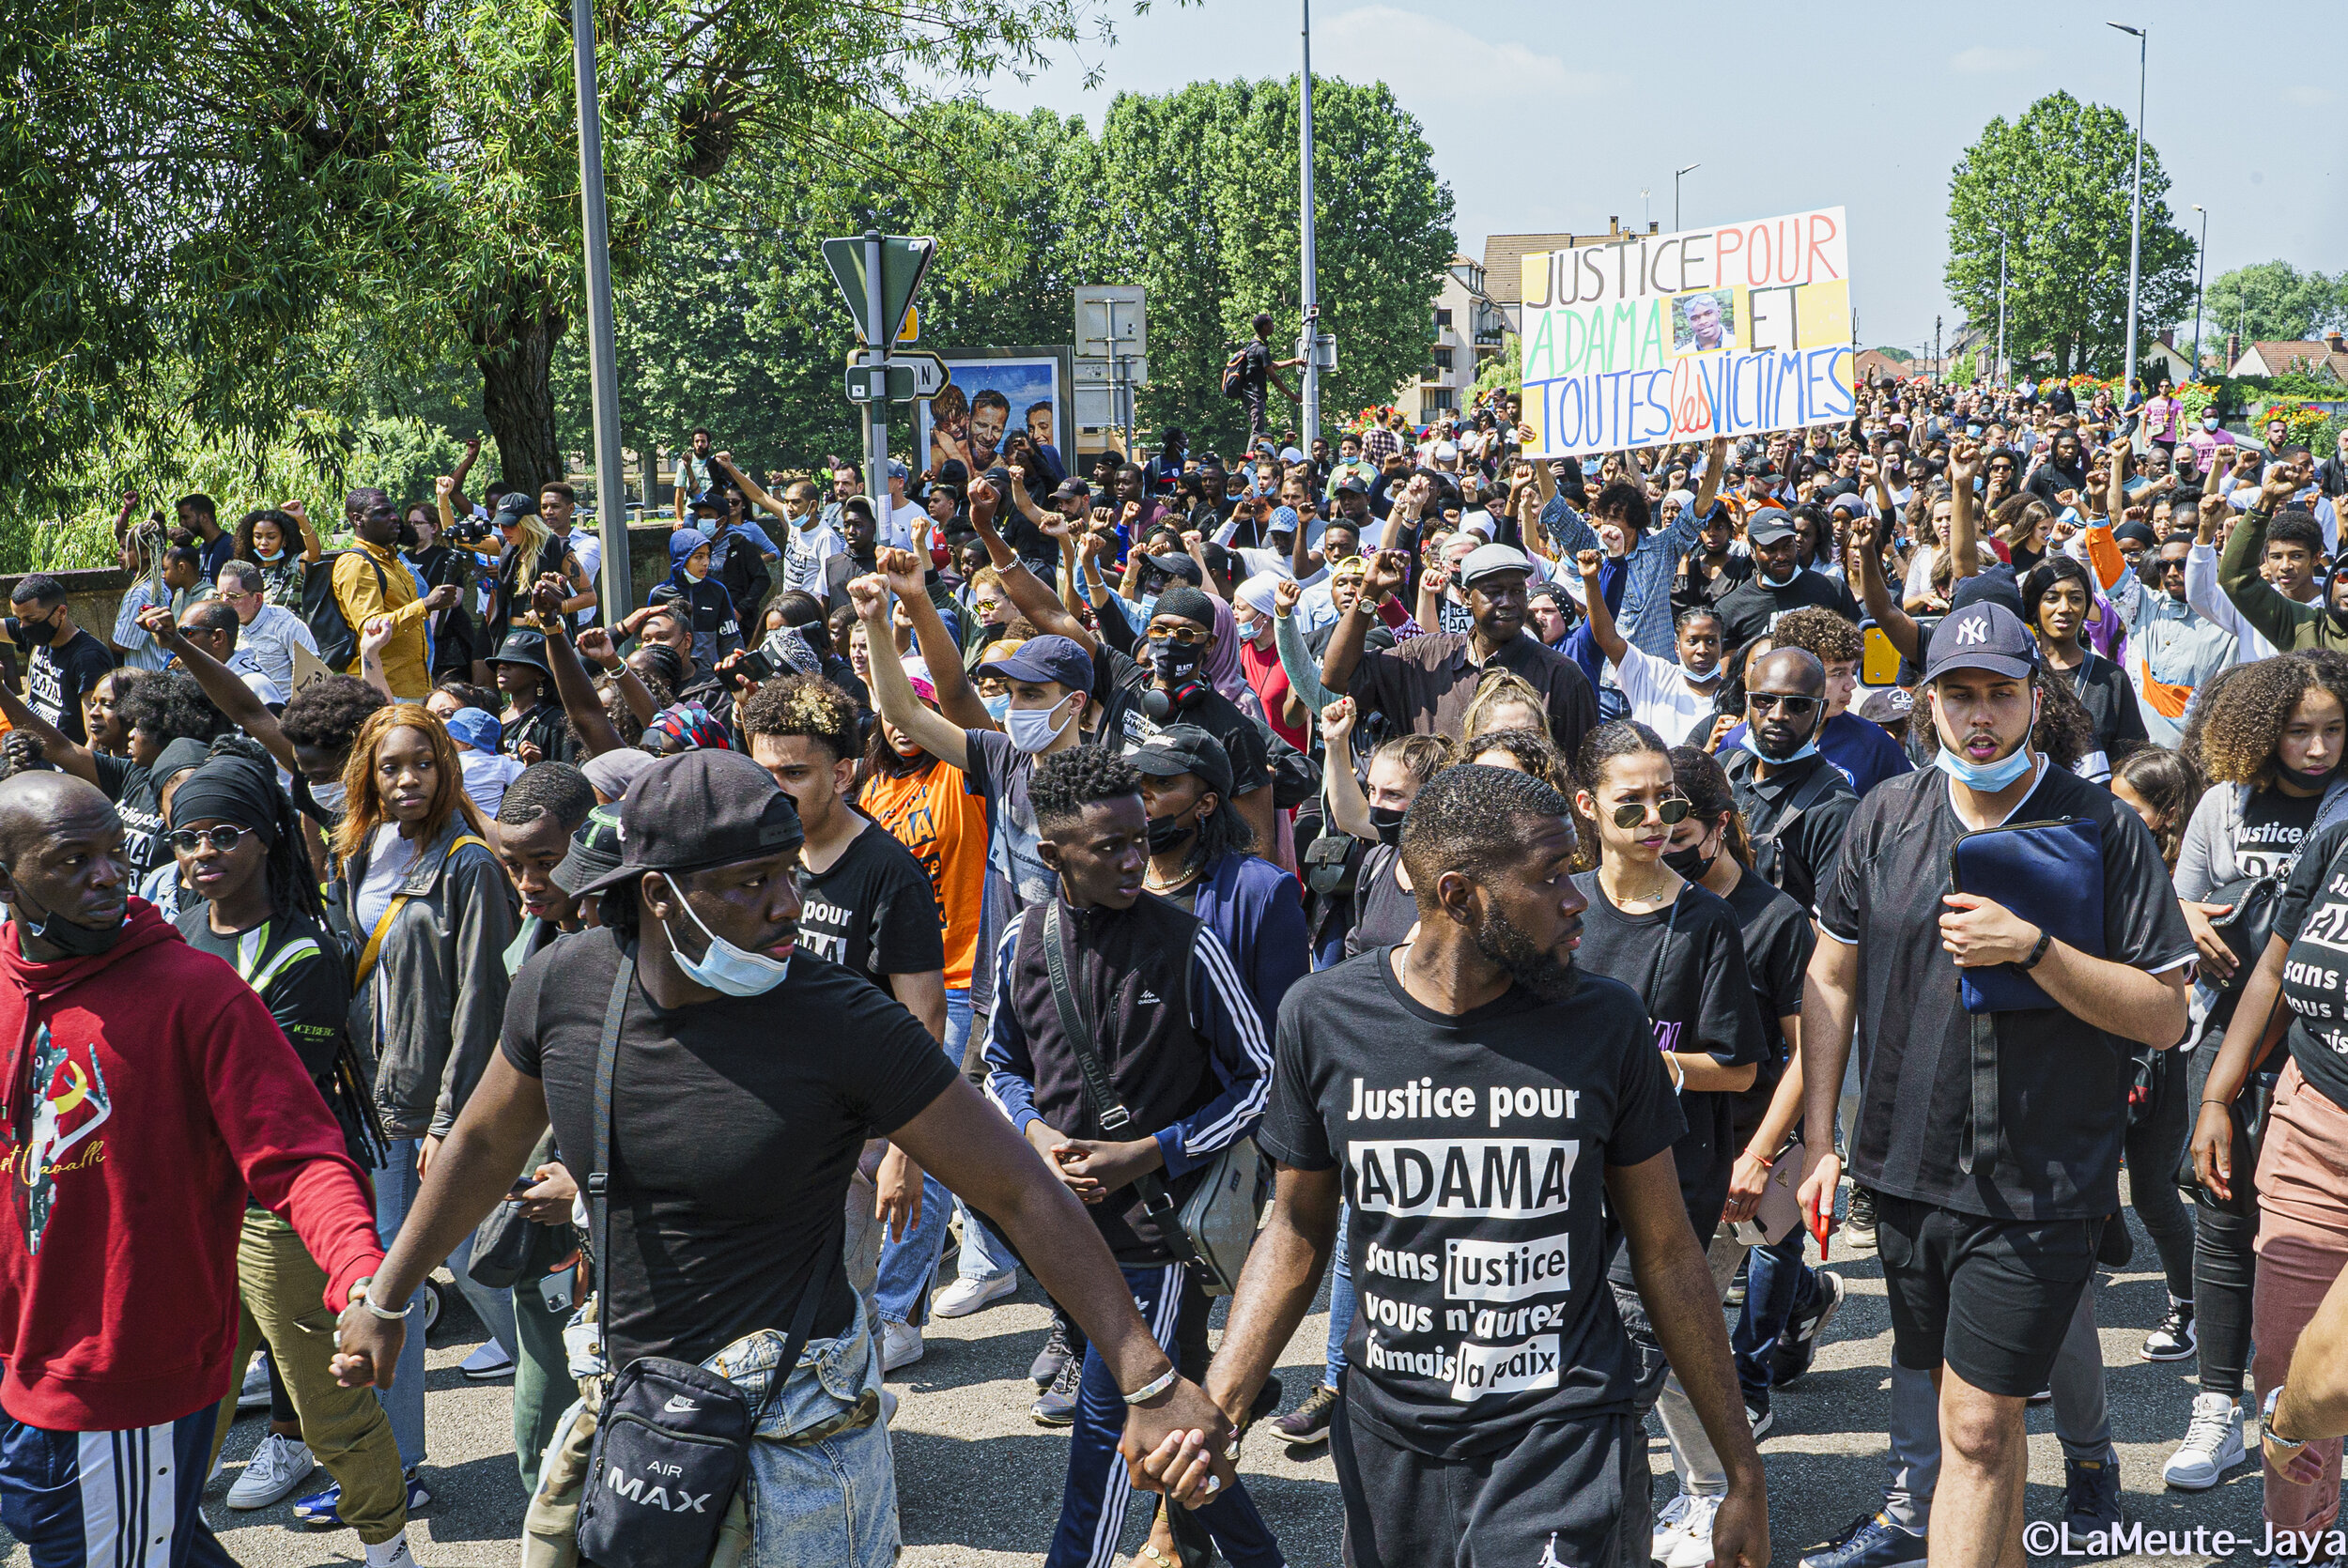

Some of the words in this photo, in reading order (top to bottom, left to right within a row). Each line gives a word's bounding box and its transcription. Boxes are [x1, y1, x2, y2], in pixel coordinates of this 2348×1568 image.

[1526, 234, 1713, 309] JUSTICE
[1715, 215, 1839, 287] POUR
[1525, 299, 1664, 379] ADAMA
[1748, 282, 1809, 353] ET
[1522, 369, 1673, 453] TOUTES
[1670, 357, 1712, 441] les
[800, 899, 853, 927] pour
[2283, 960, 2340, 991] sans
[1347, 1077, 1476, 1121] Justice
[1490, 1086, 1580, 1128] pour
[1361, 1145, 1568, 1210] ADAMA
[1366, 1241, 1439, 1282] sans
[1449, 1243, 1567, 1295] justice
[1366, 1291, 1433, 1333] vous
[1445, 1300, 1567, 1339] n'aurez
[1366, 1329, 1457, 1382] jamais
[1460, 1347, 1485, 1388] la
[1489, 1343, 1557, 1389] paix
[672, 1394, 695, 1409] NIKE
[608, 1466, 713, 1514] MAX
[646, 1460, 683, 1478] AIR
